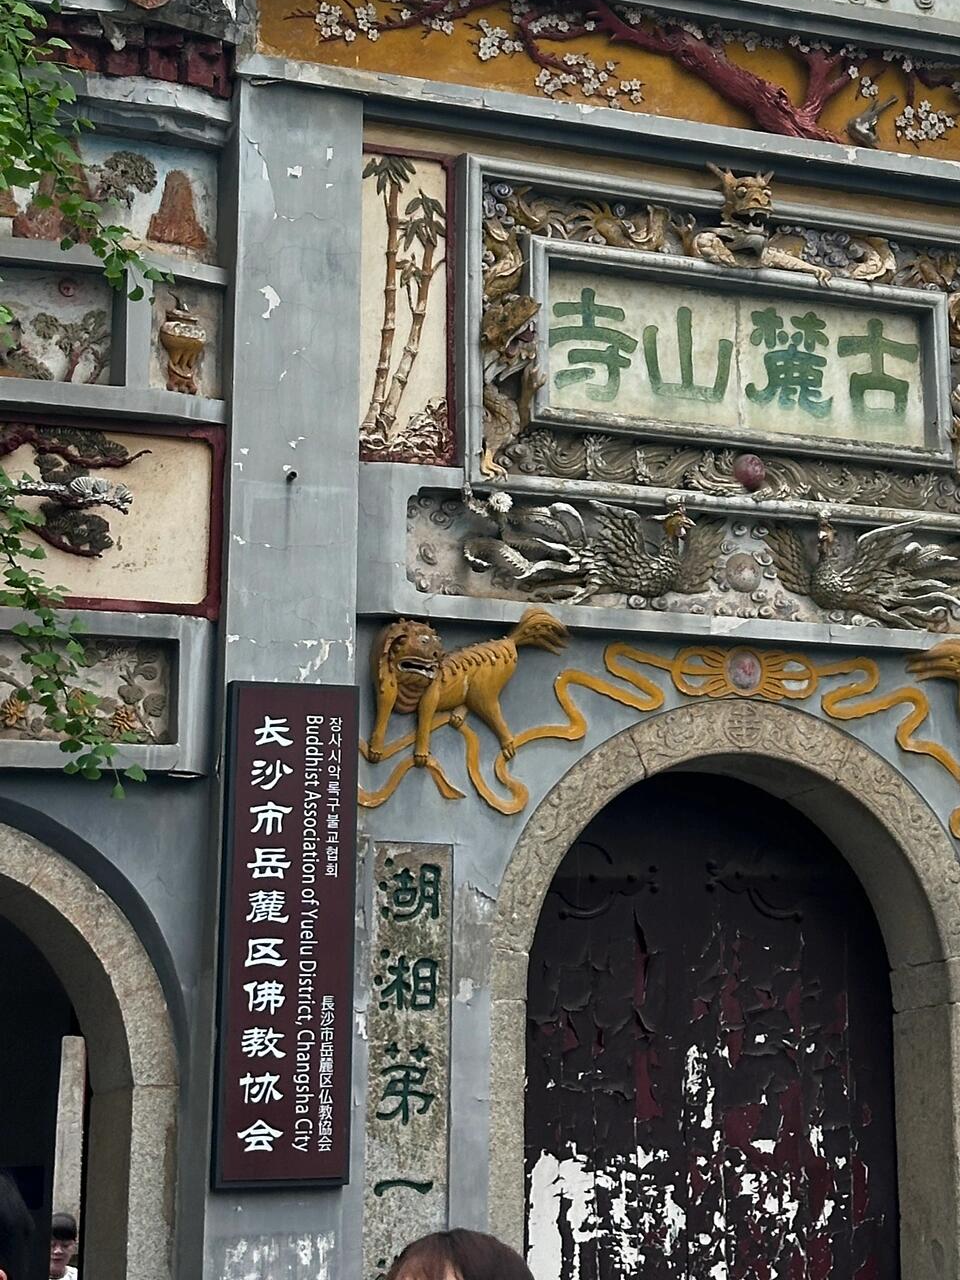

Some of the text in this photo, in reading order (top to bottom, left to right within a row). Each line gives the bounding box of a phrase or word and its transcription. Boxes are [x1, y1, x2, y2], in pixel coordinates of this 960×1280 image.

[236, 715, 294, 1152] 长沙市岳麓区佛教协会
[291, 715, 324, 1152] Buddhist Association of Yuelu District, Changsha City
[375, 857, 442, 1280] 湖湘第一
